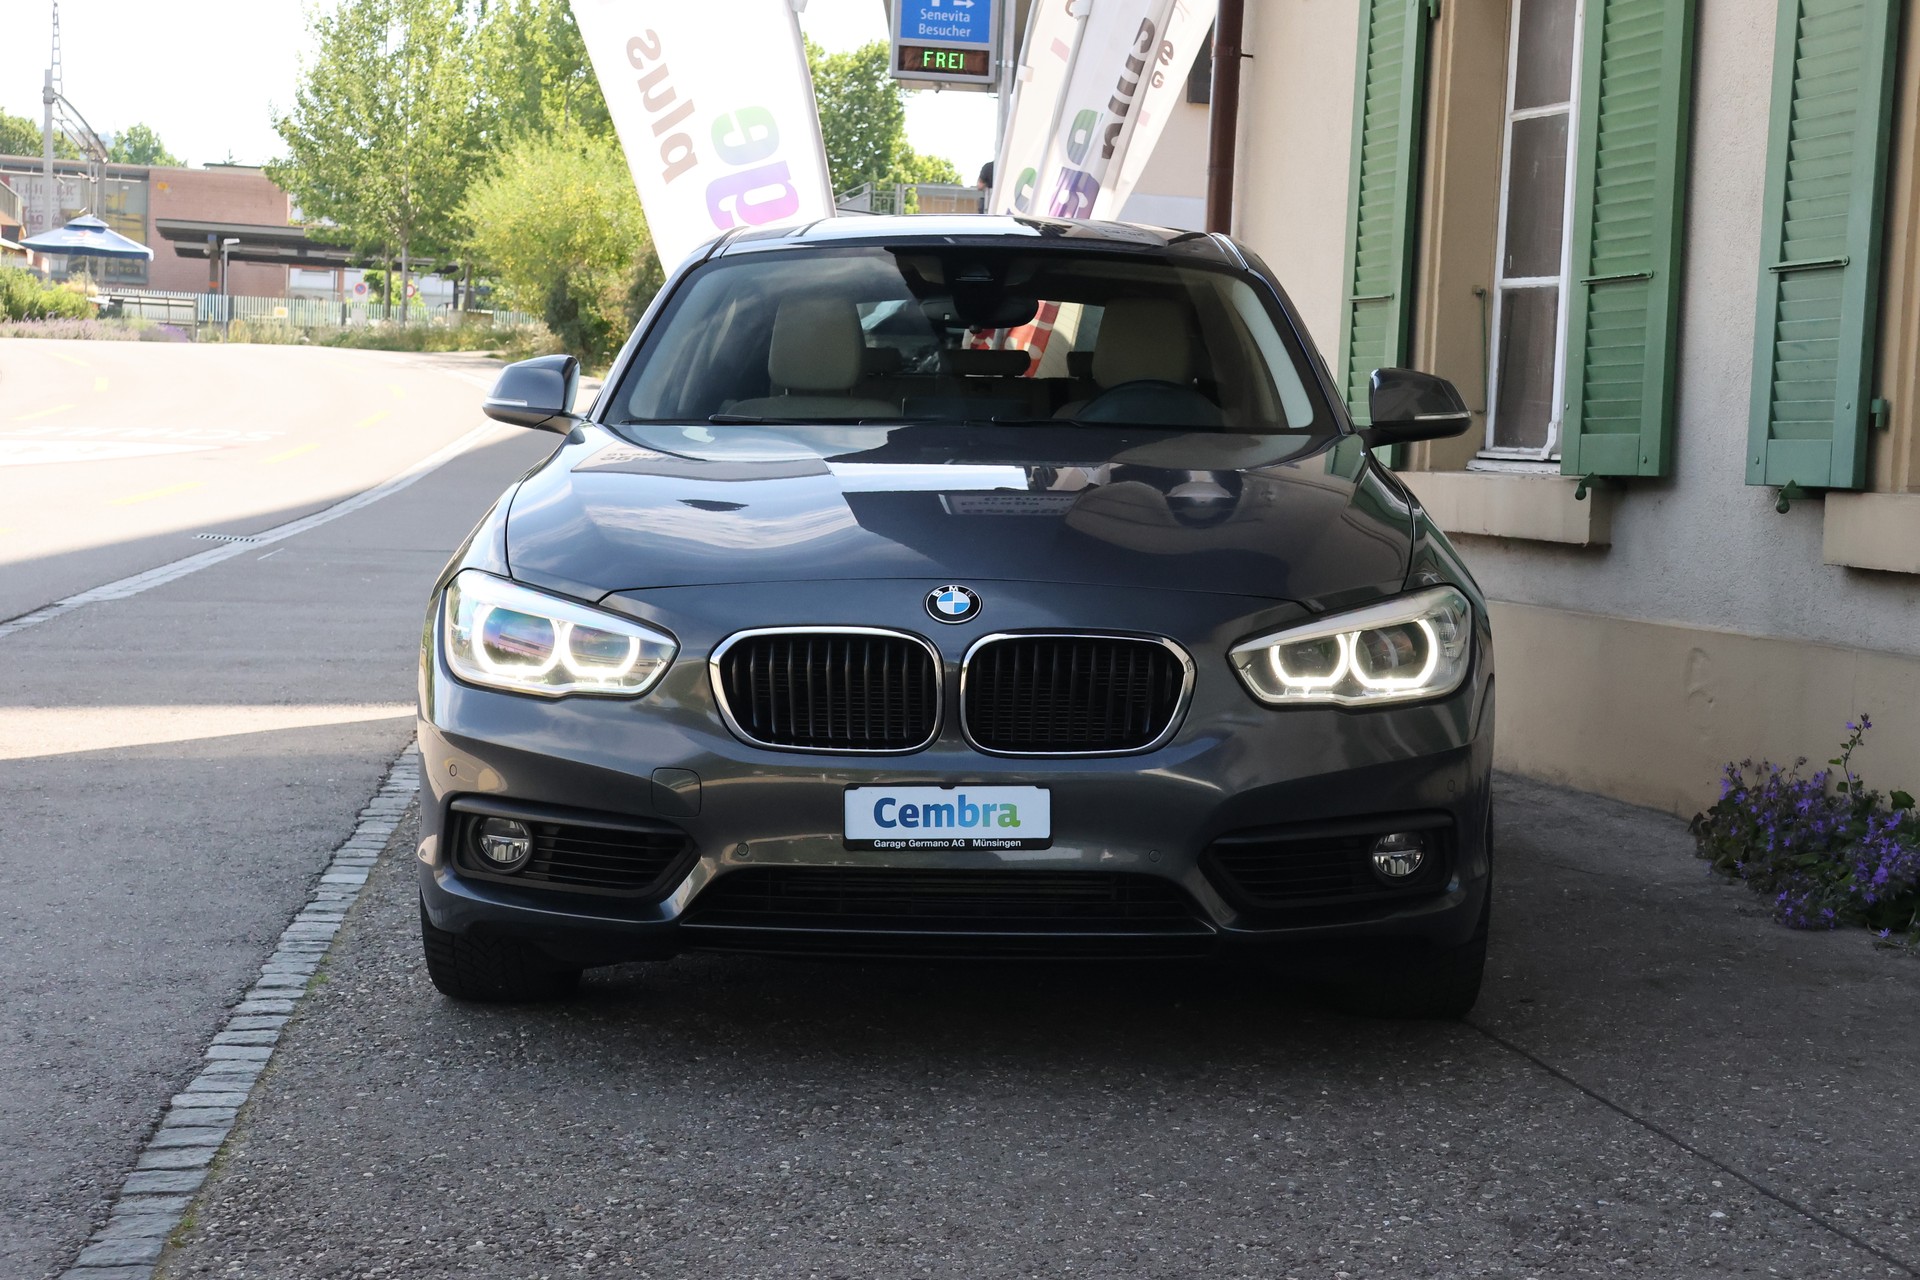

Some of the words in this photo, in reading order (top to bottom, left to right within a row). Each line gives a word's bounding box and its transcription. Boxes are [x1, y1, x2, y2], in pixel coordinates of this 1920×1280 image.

[920, 8, 970, 22] Senevita
[918, 23, 971, 37] Besucher
[923, 51, 964, 69] FREI
[873, 794, 1021, 829] Cembra
[874, 839, 906, 849] Garage
[908, 839, 949, 848] Germano
[951, 839, 965, 848] AG
[972, 839, 1021, 849] Münsingen
